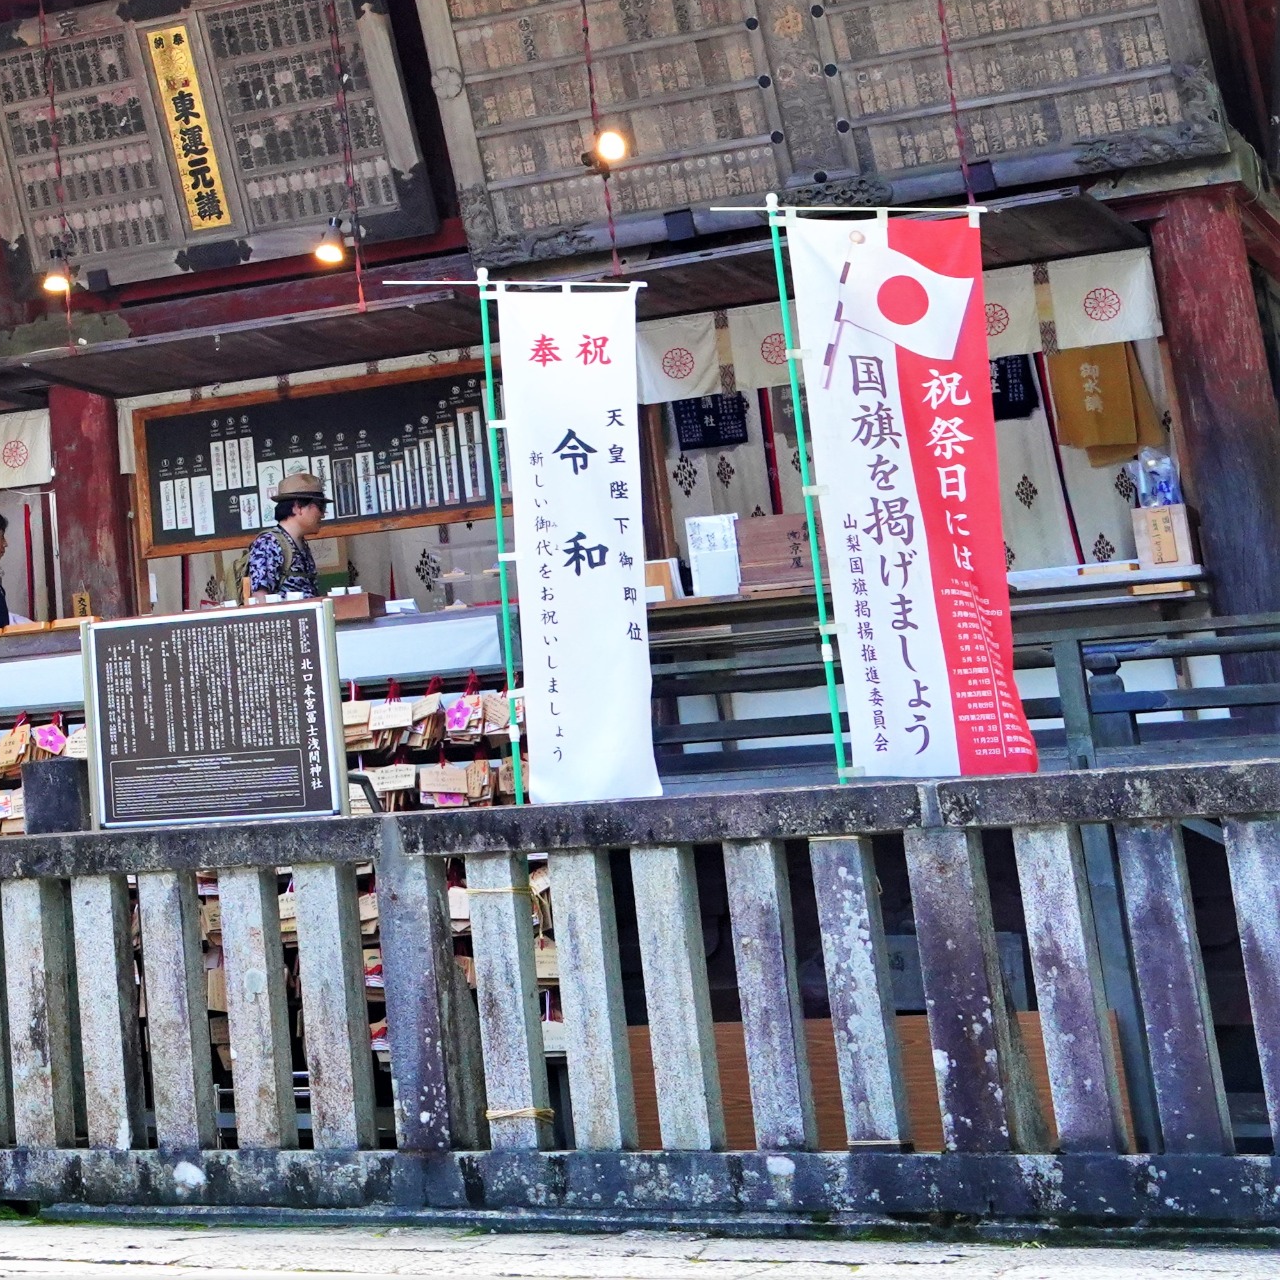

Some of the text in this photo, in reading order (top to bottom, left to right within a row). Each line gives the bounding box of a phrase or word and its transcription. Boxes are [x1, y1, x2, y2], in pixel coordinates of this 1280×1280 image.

[171, 90, 224, 220] 東運元講
[528, 333, 612, 367] 奉祝
[552, 428, 610, 577] 令和
[606, 408, 643, 642] 天皇陛下御即位
[848, 355, 932, 755] 国旗を掲げましょう
[921, 368, 975, 572] 祝祭日には
[529, 450, 564, 762] 新しい御代をお祝いしましょう
[842, 513, 889, 752] 山梨国旗掲揚推進委員会
